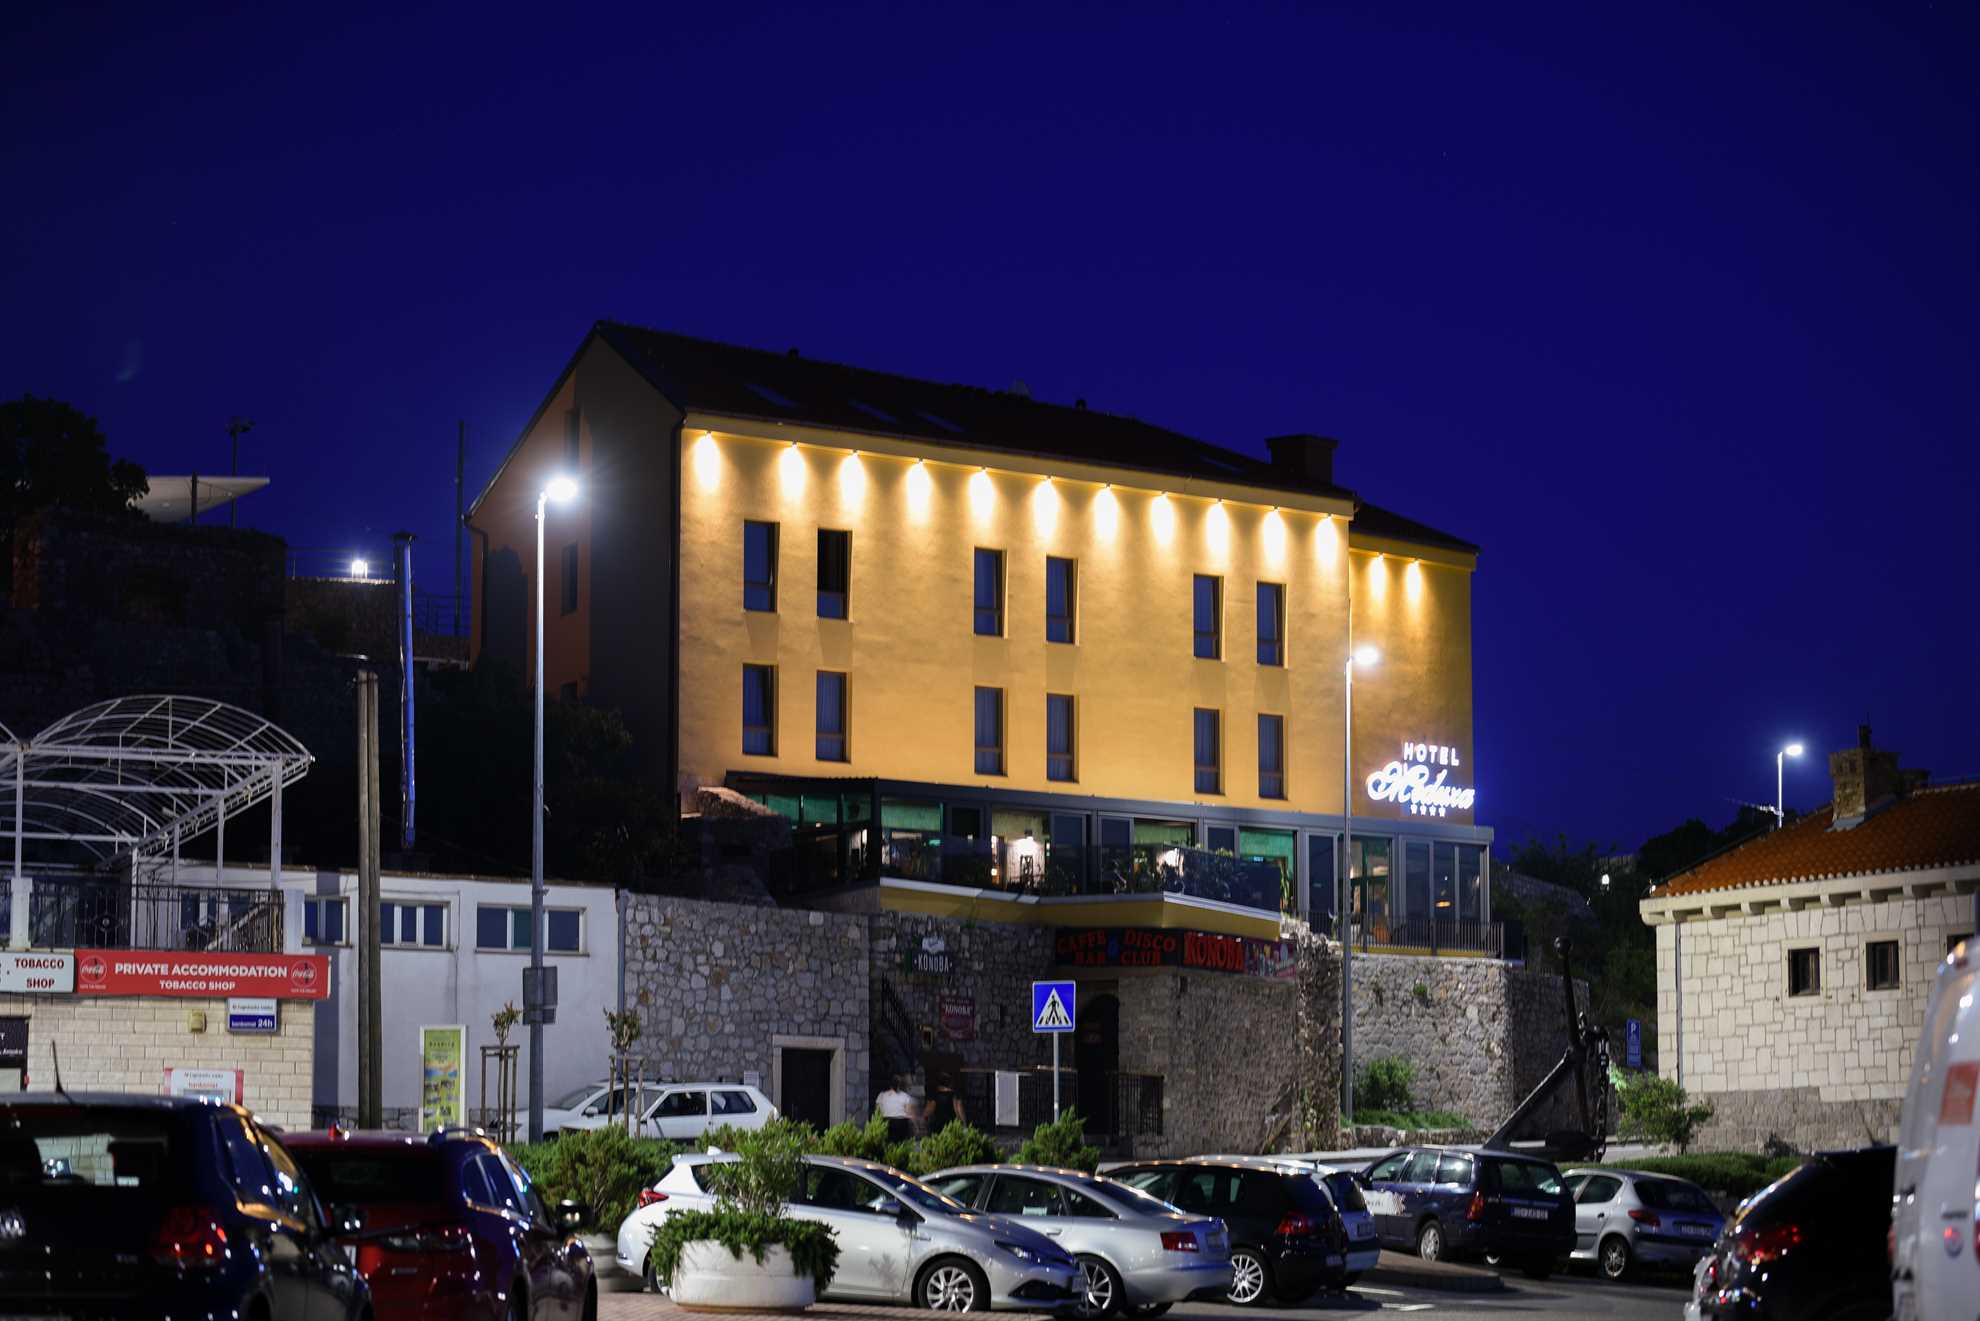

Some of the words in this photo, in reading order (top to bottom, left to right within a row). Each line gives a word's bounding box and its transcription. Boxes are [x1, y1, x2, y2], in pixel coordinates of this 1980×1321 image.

[1403, 742, 1460, 766] HOTEL
[1123, 928, 1177, 952] DISCO
[15, 958, 65, 969] TOBACCO
[114, 962, 169, 976] PRIVATE
[171, 964, 288, 978] ACCOMMODATION
[26, 977, 55, 989] SHOP
[159, 979, 207, 990] TOBACCO
[208, 981, 237, 991] SHOP
